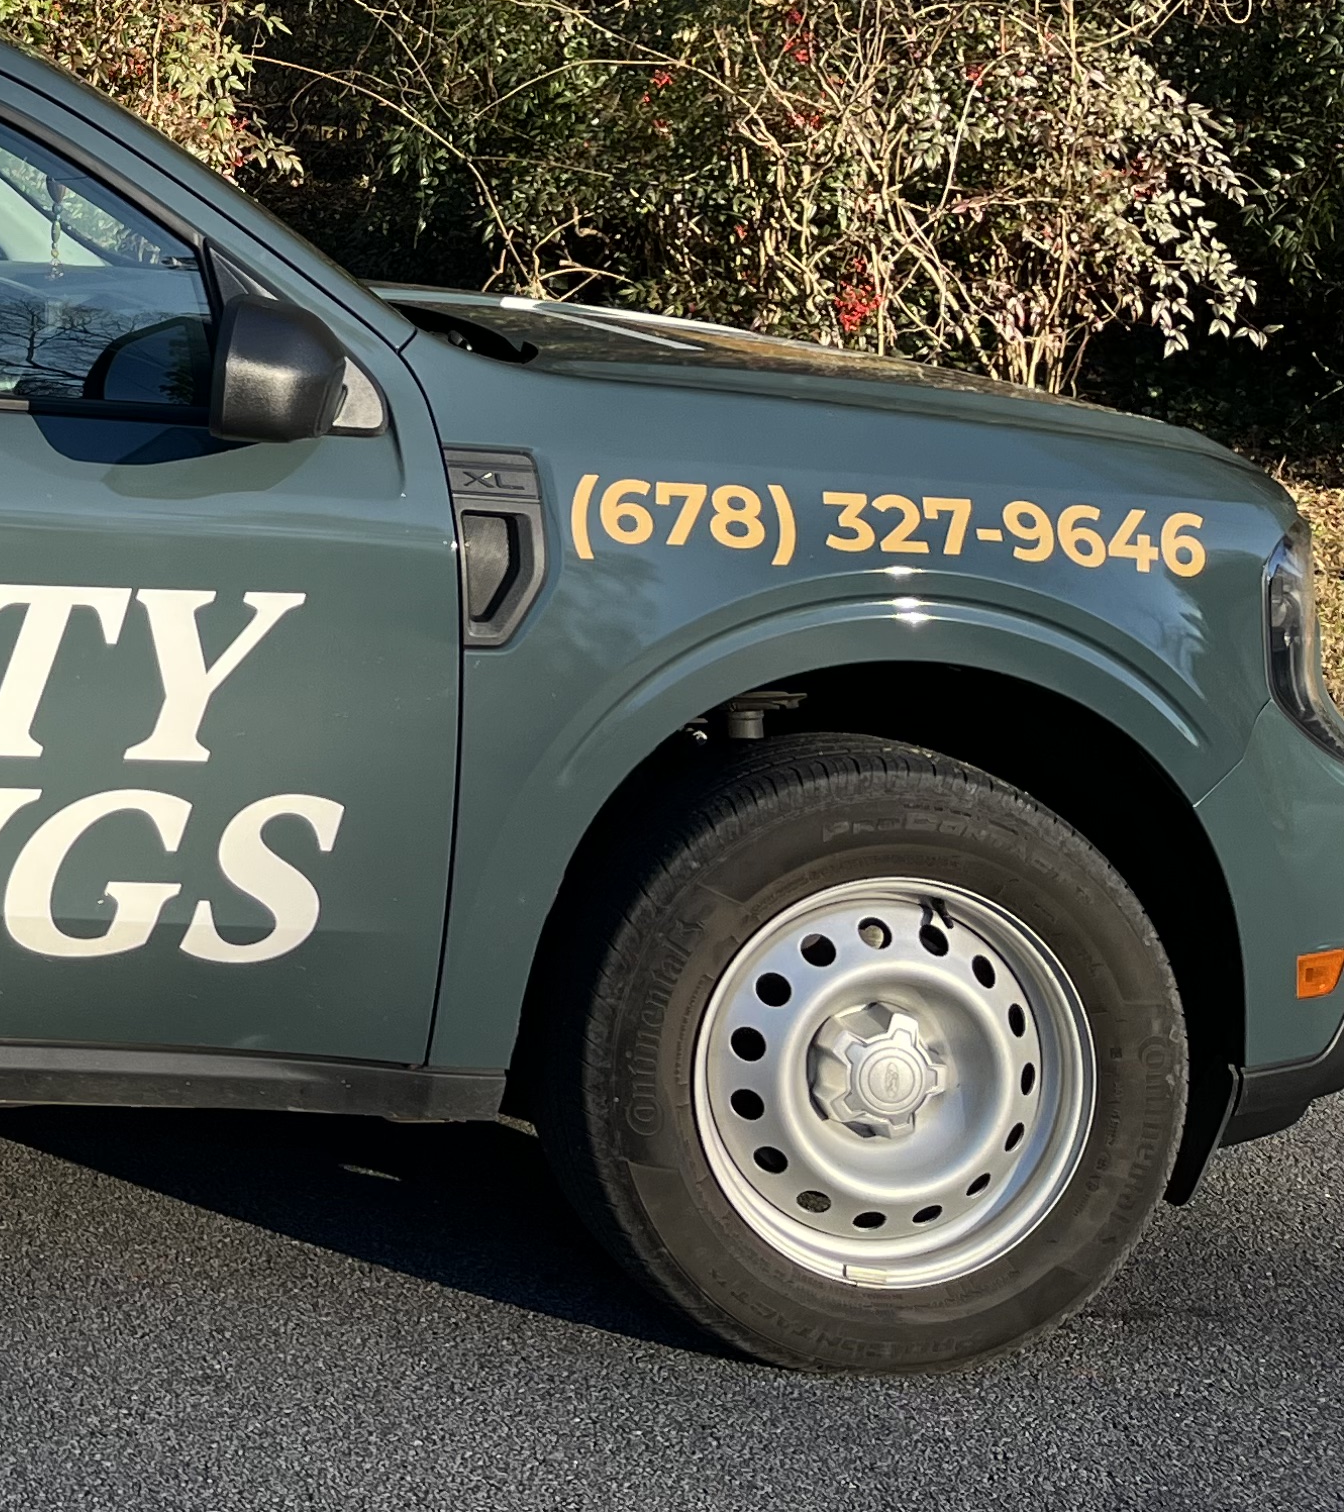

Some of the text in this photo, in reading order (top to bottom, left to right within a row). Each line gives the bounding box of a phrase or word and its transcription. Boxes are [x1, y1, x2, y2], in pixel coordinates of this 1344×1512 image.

[462, 471, 525, 490] XL
[571, 473, 1206, 578] (678) 327-9646
